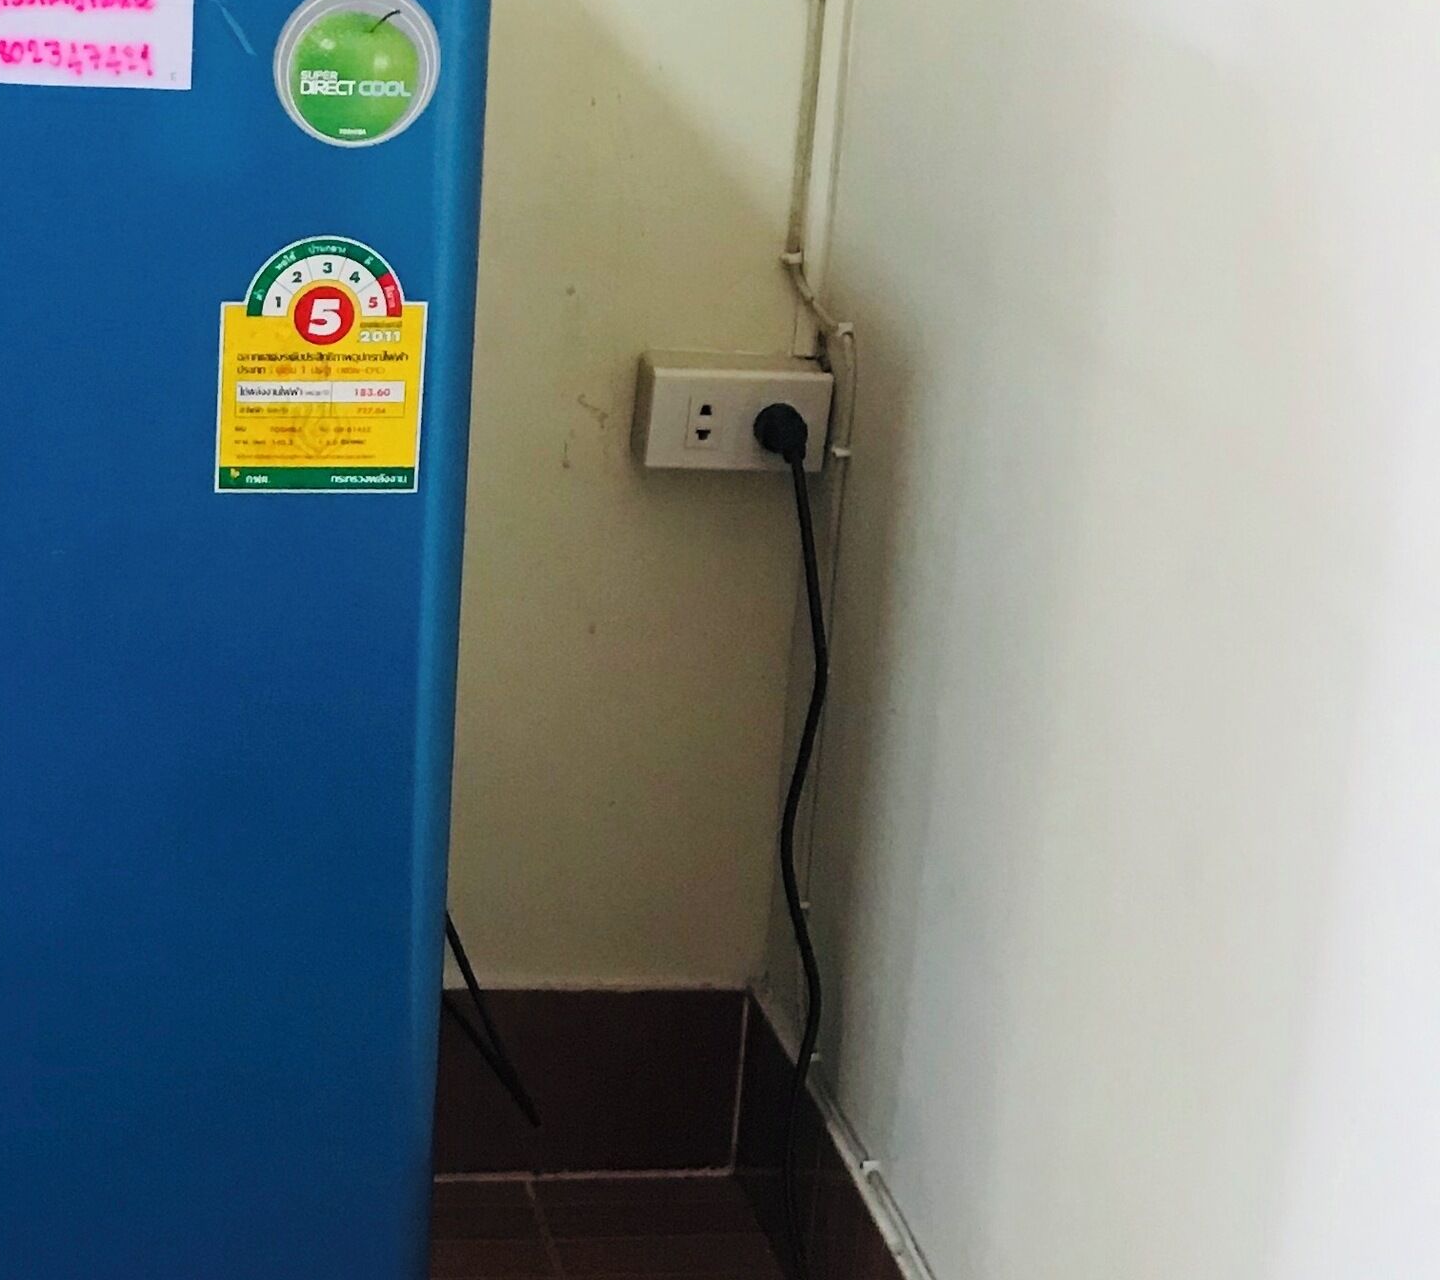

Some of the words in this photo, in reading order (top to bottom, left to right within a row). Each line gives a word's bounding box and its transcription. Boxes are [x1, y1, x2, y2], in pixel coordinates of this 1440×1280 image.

[300, 70, 338, 80] SUPER
[300, 80, 356, 96] DIRECT
[358, 80, 412, 97] COOL
[274, 296, 282, 308] 1
[292, 271, 303, 283] 2
[322, 262, 333, 274] 3
[349, 271, 361, 283] 4
[368, 296, 378, 308] 5
[307, 298, 342, 336] 5
[359, 330, 401, 343] 2011
[354, 388, 391, 397] 183.60
